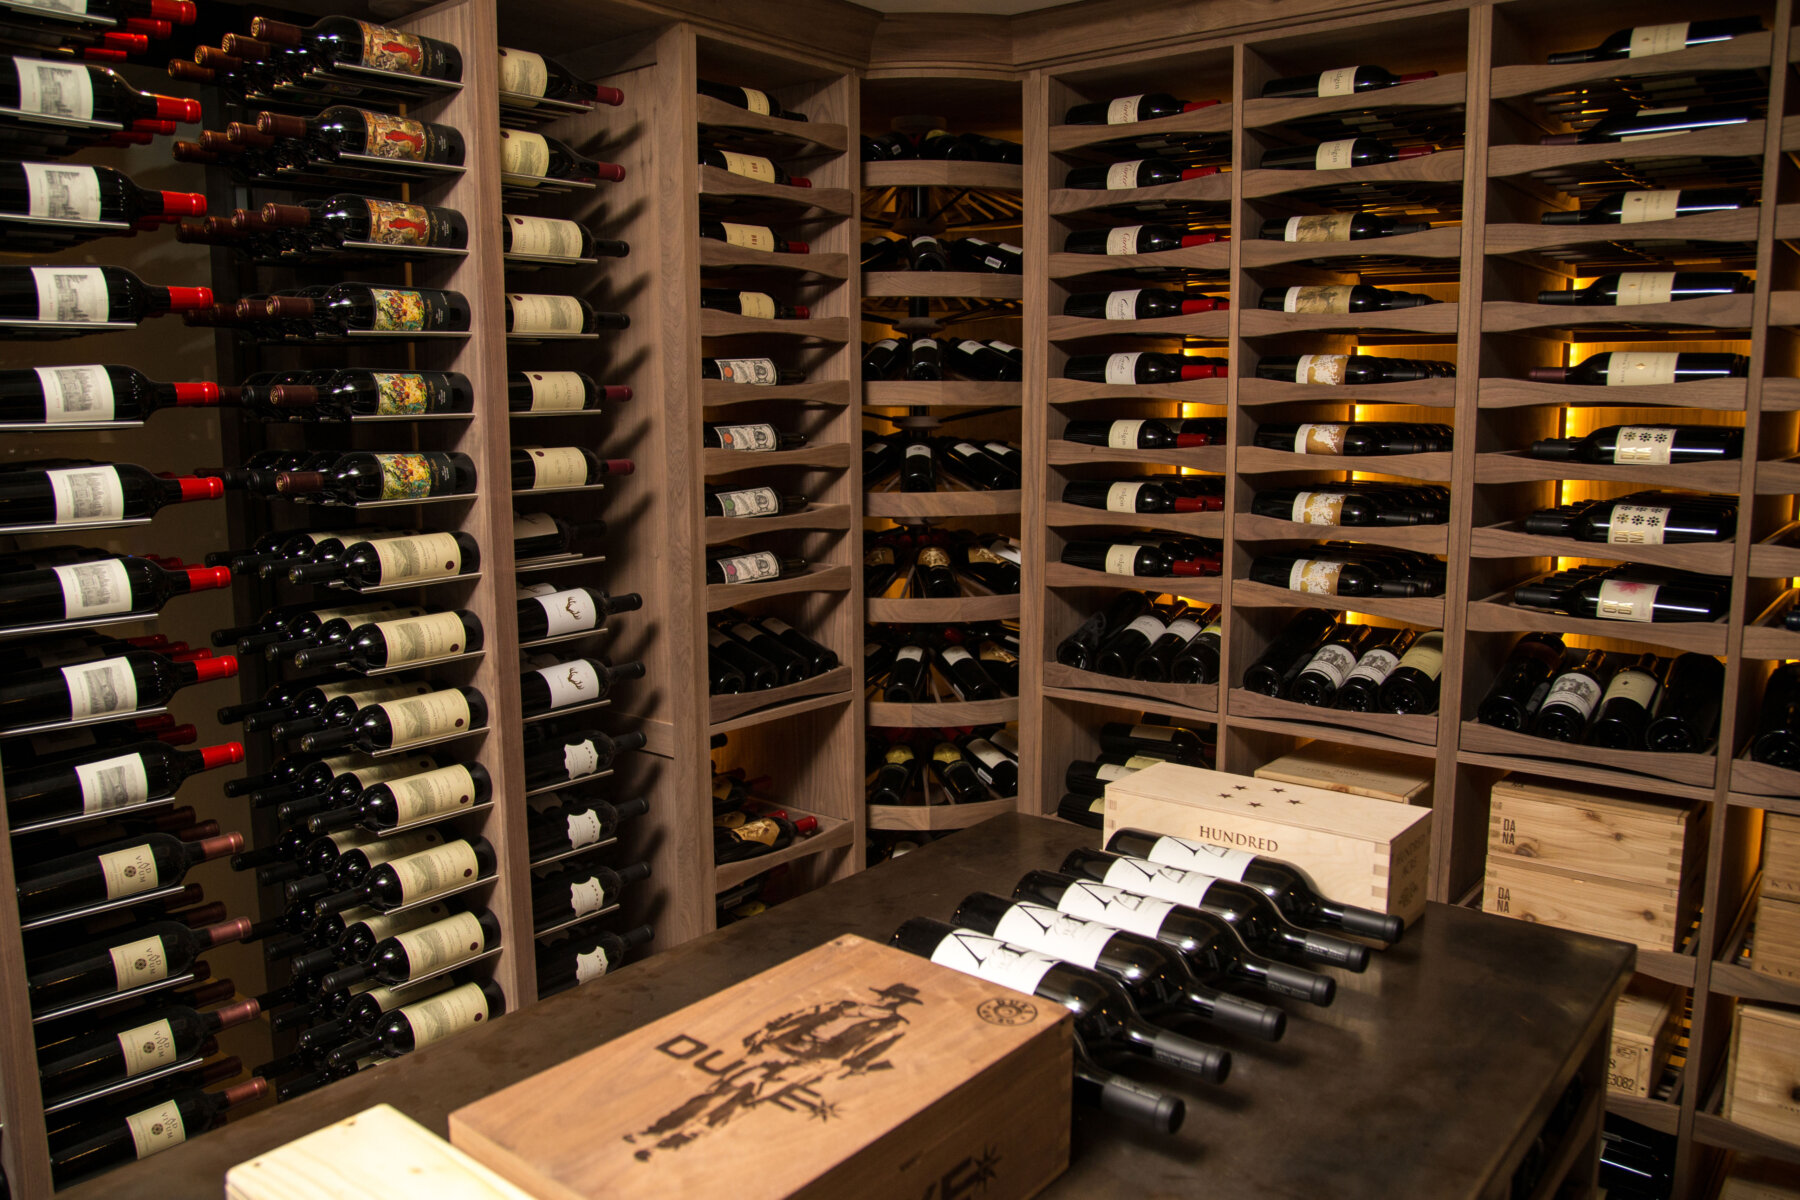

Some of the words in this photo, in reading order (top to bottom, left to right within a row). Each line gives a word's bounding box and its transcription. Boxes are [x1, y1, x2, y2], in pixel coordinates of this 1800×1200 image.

[1503, 818, 1516, 832] DA
[1200, 825, 1279, 853] HUNDRED
[1502, 832, 1515, 846] NA
[134, 855, 146, 883] VIVUM
[142, 862, 152, 873] AD
[1498, 887, 1511, 901] DA
[1497, 899, 1510, 913] NA
[144, 947, 156, 975] VIVUM
[153, 954, 162, 966] AD
[153, 1031, 165, 1058] VIVUM
[161, 1037, 170, 1048] AD
[655, 1033, 822, 1113] DUE
[161, 1112, 173, 1139] VIVUM
[169, 1118, 178, 1129] AD
